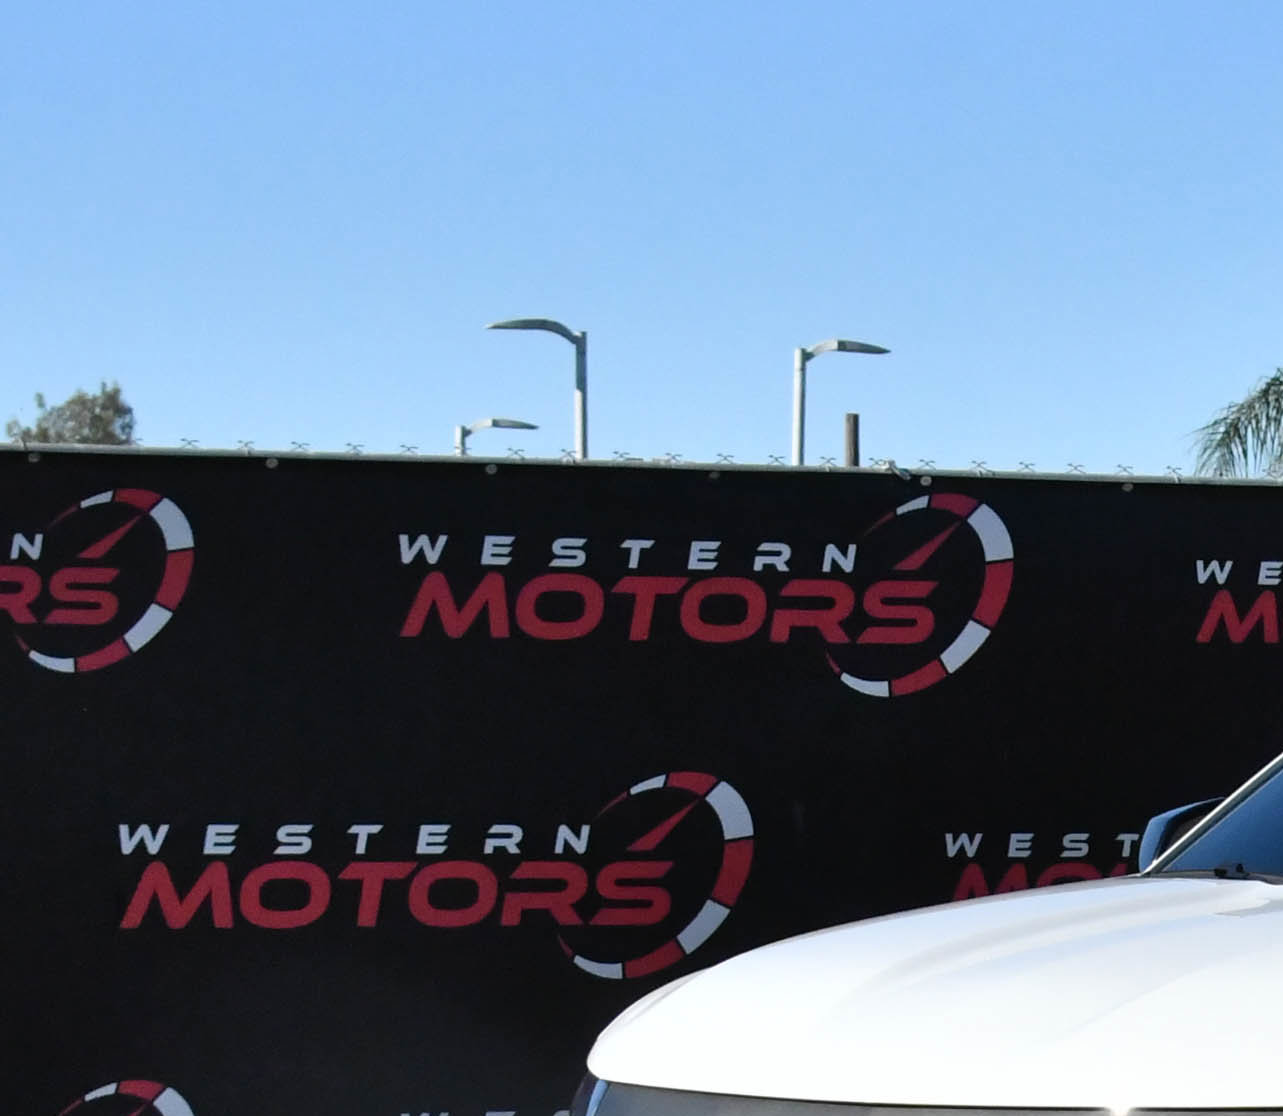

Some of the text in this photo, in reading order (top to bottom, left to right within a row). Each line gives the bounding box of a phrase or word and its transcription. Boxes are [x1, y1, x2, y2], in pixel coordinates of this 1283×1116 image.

[399, 534, 858, 573] WESTERN
[400, 571, 939, 644] MOTORS
[118, 824, 592, 854] WESTERN
[945, 833, 1140, 858] WEST
[120, 861, 674, 929] MOTORS
